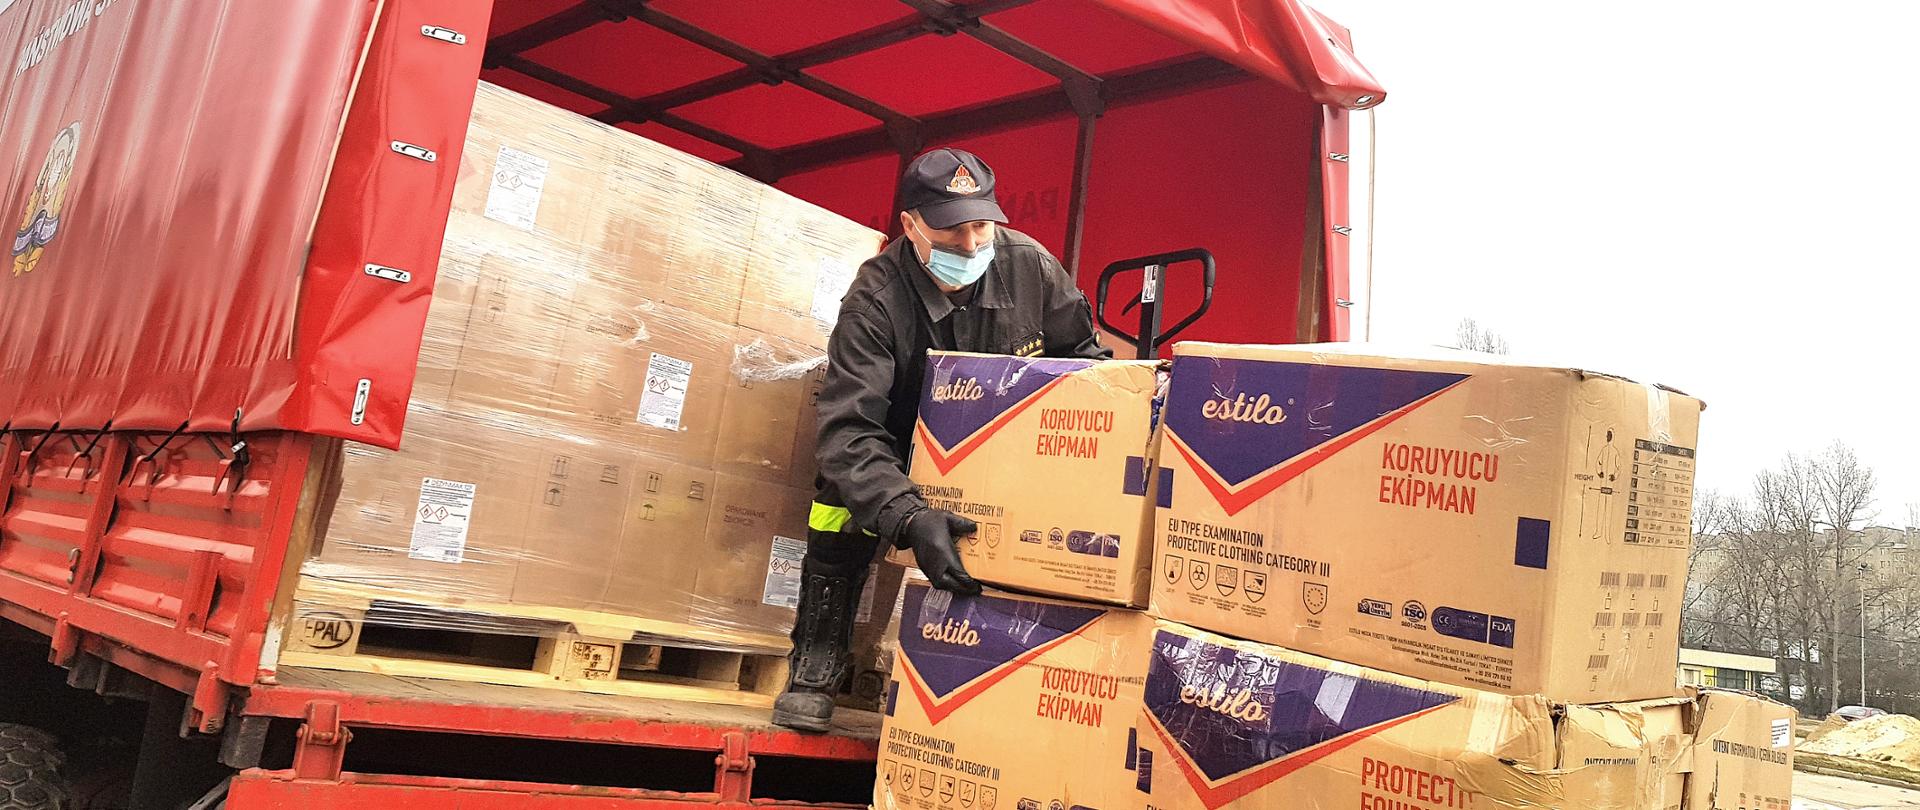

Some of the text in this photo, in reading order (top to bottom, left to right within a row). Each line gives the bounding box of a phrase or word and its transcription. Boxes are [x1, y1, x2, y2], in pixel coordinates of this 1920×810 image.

[935, 377, 985, 401] estilo
[1040, 408, 1114, 433] KORUYUCU
[1202, 392, 1287, 425] estilo
[1036, 431, 1099, 459] EKİPMAN
[1382, 442, 1499, 482] KORUYUCU
[963, 502, 997, 517] CATEGORY
[1379, 474, 1476, 515] EKİPMAN
[1168, 518, 1264, 548] EU TYPE EXAMINATION
[1167, 534, 1331, 578] PROTECTIVE CLOTHING CATEGORY III
[1404, 608, 1425, 619] ISO
[1492, 621, 1513, 633] FDA
[922, 617, 981, 646] estilo
[1041, 665, 1119, 700] KORUYUCU
[1037, 692, 1102, 728] EKİPMAN
[1180, 682, 1266, 722] estilo
[889, 727, 898, 739] EU
[898, 729, 912, 744] TYPE
[887, 741, 922, 761] PROTECTIVE
[955, 759, 992, 779] CATEGORY
[992, 768, 1001, 781] III
